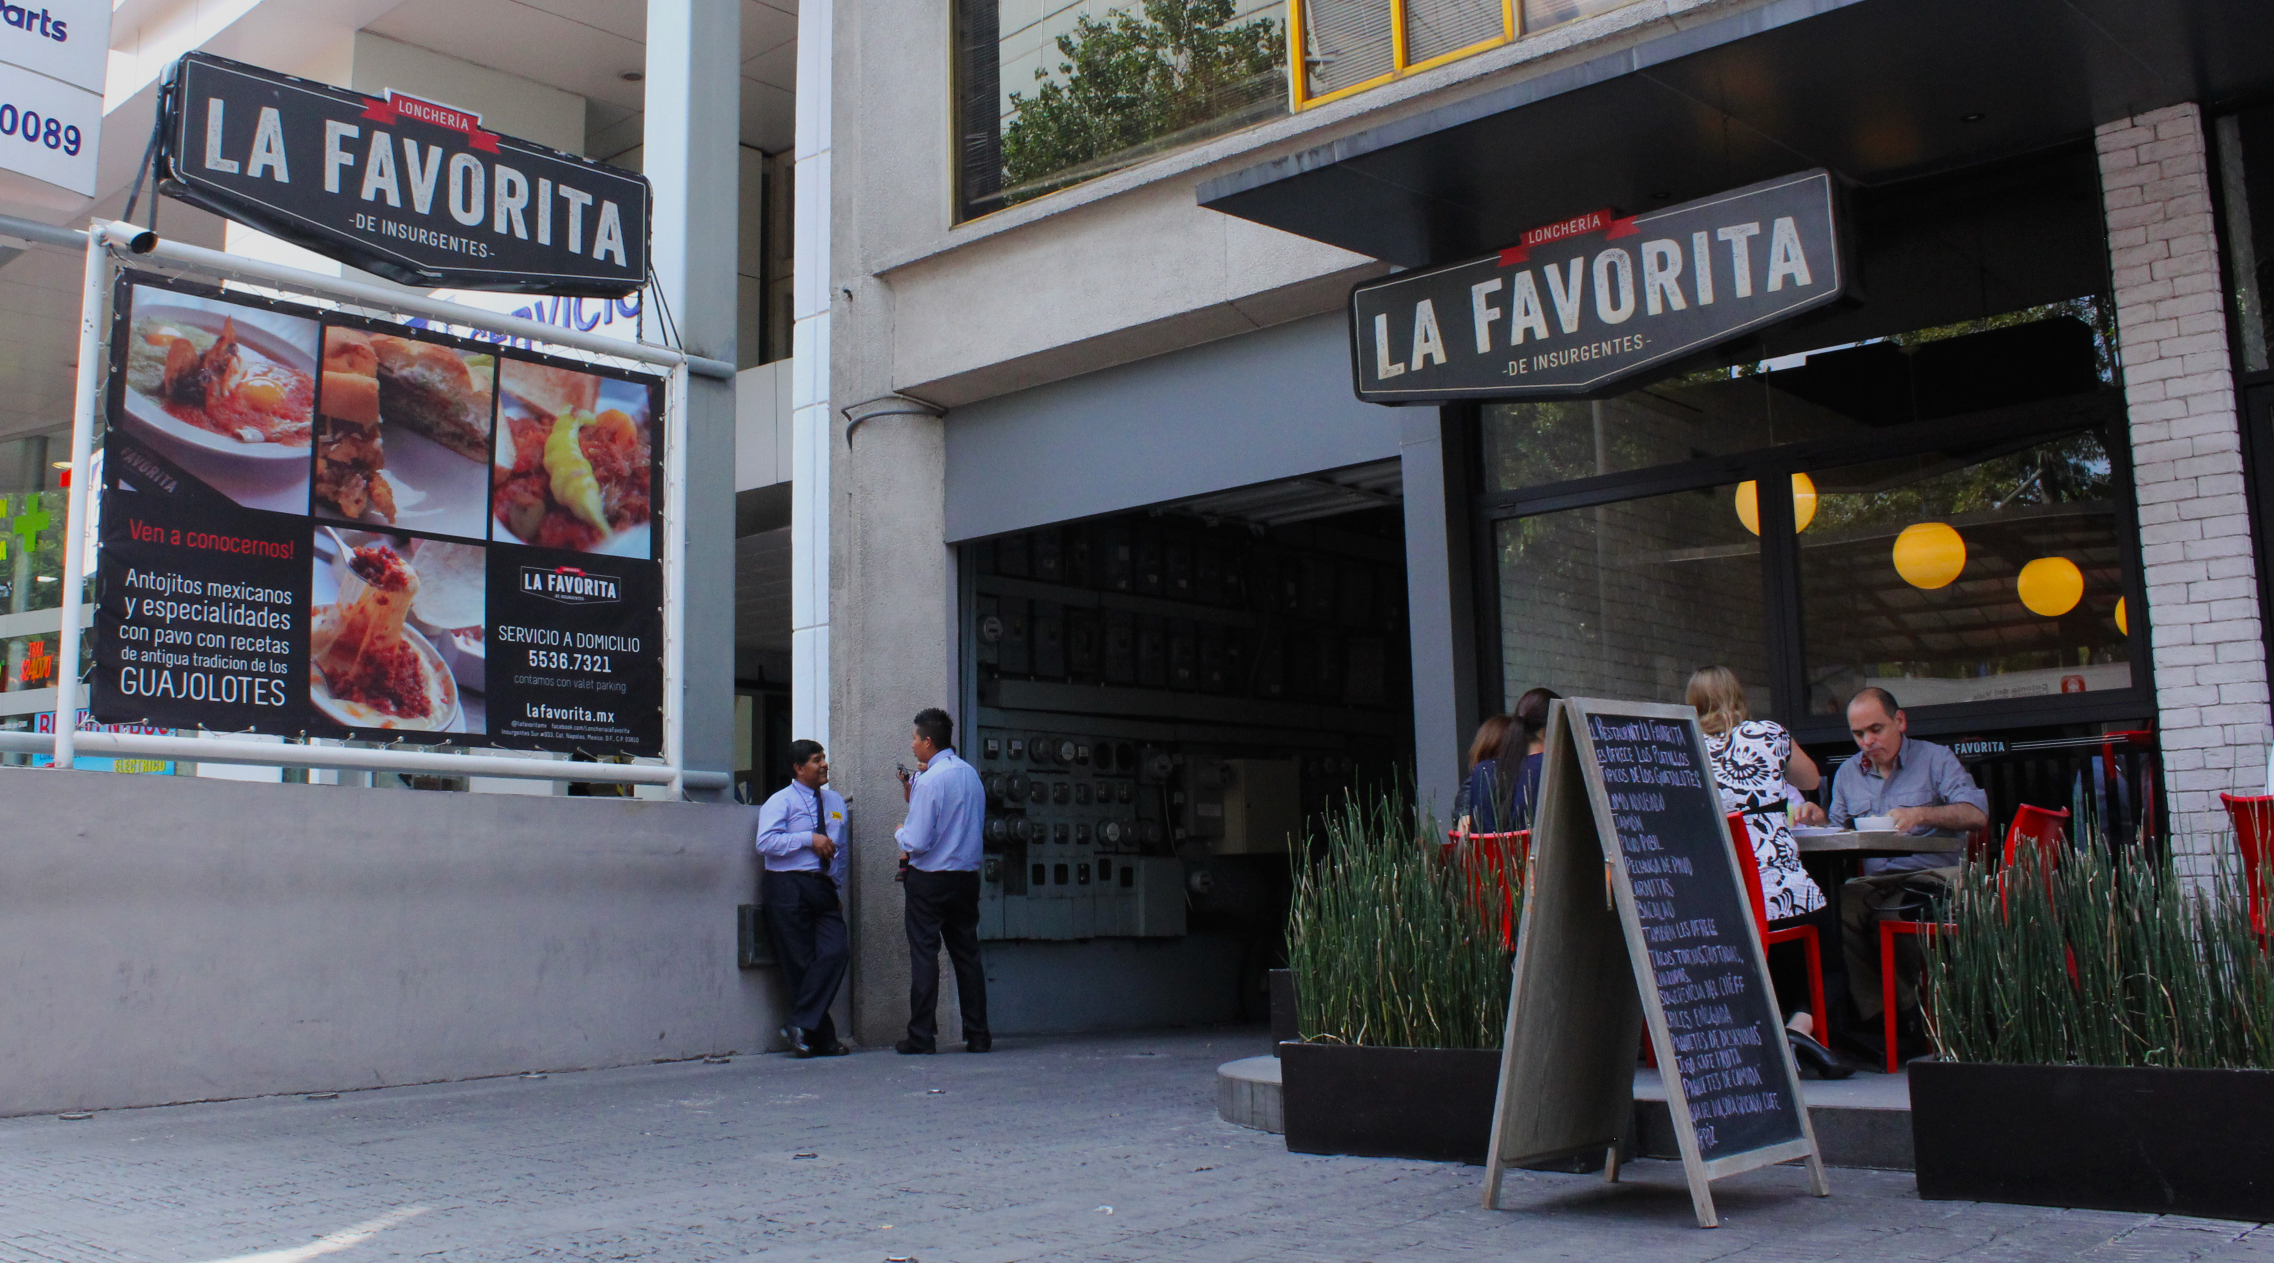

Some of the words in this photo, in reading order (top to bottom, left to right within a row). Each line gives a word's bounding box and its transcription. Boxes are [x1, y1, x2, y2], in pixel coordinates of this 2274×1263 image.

[0, 0, 68, 43] arts
[0, 103, 82, 157] 0089
[397, 97, 470, 131] LONCHERÍA
[203, 97, 291, 184] LA
[322, 119, 628, 268] FAVORITA
[1528, 213, 1602, 245] LONCHERÍA
[1374, 298, 1447, 381] LA
[1470, 216, 1812, 355] FAVORITA
[120, 446, 179, 494] FAVORITA
[129, 519, 164, 543] Ven
[170, 530, 181, 545] a
[187, 531, 295, 560] conocernos!
[125, 568, 202, 596] Antojitos
[207, 582, 292, 605] mexicanos
[524, 573, 542, 591] LA
[548, 574, 616, 598] FAVORITA
[124, 597, 137, 619] y
[143, 599, 291, 630] especialidades
[119, 625, 149, 642] con
[154, 628, 192, 647] pavo
[197, 632, 225, 649] con
[231, 635, 290, 655] recetas
[498, 625, 559, 646] SERVICIO
[563, 631, 573, 647] A
[577, 633, 640, 653] DOMICILIO
[121, 646, 137, 660] de
[141, 649, 189, 667] antigua
[193, 652, 248, 671] tradicion
[251, 657, 266, 672] de
[270, 659, 288, 674] los
[529, 650, 612, 673] 5536.7321
[120, 666, 286, 707] GUAJOLOTES
[514, 674, 555, 686] contamos
[556, 678, 572, 688] con
[574, 678, 594, 690] valet
[596, 680, 627, 694] parking
[526, 702, 615, 723] lafavorita.mx
[1954, 741, 2005, 755] FAVORITA
